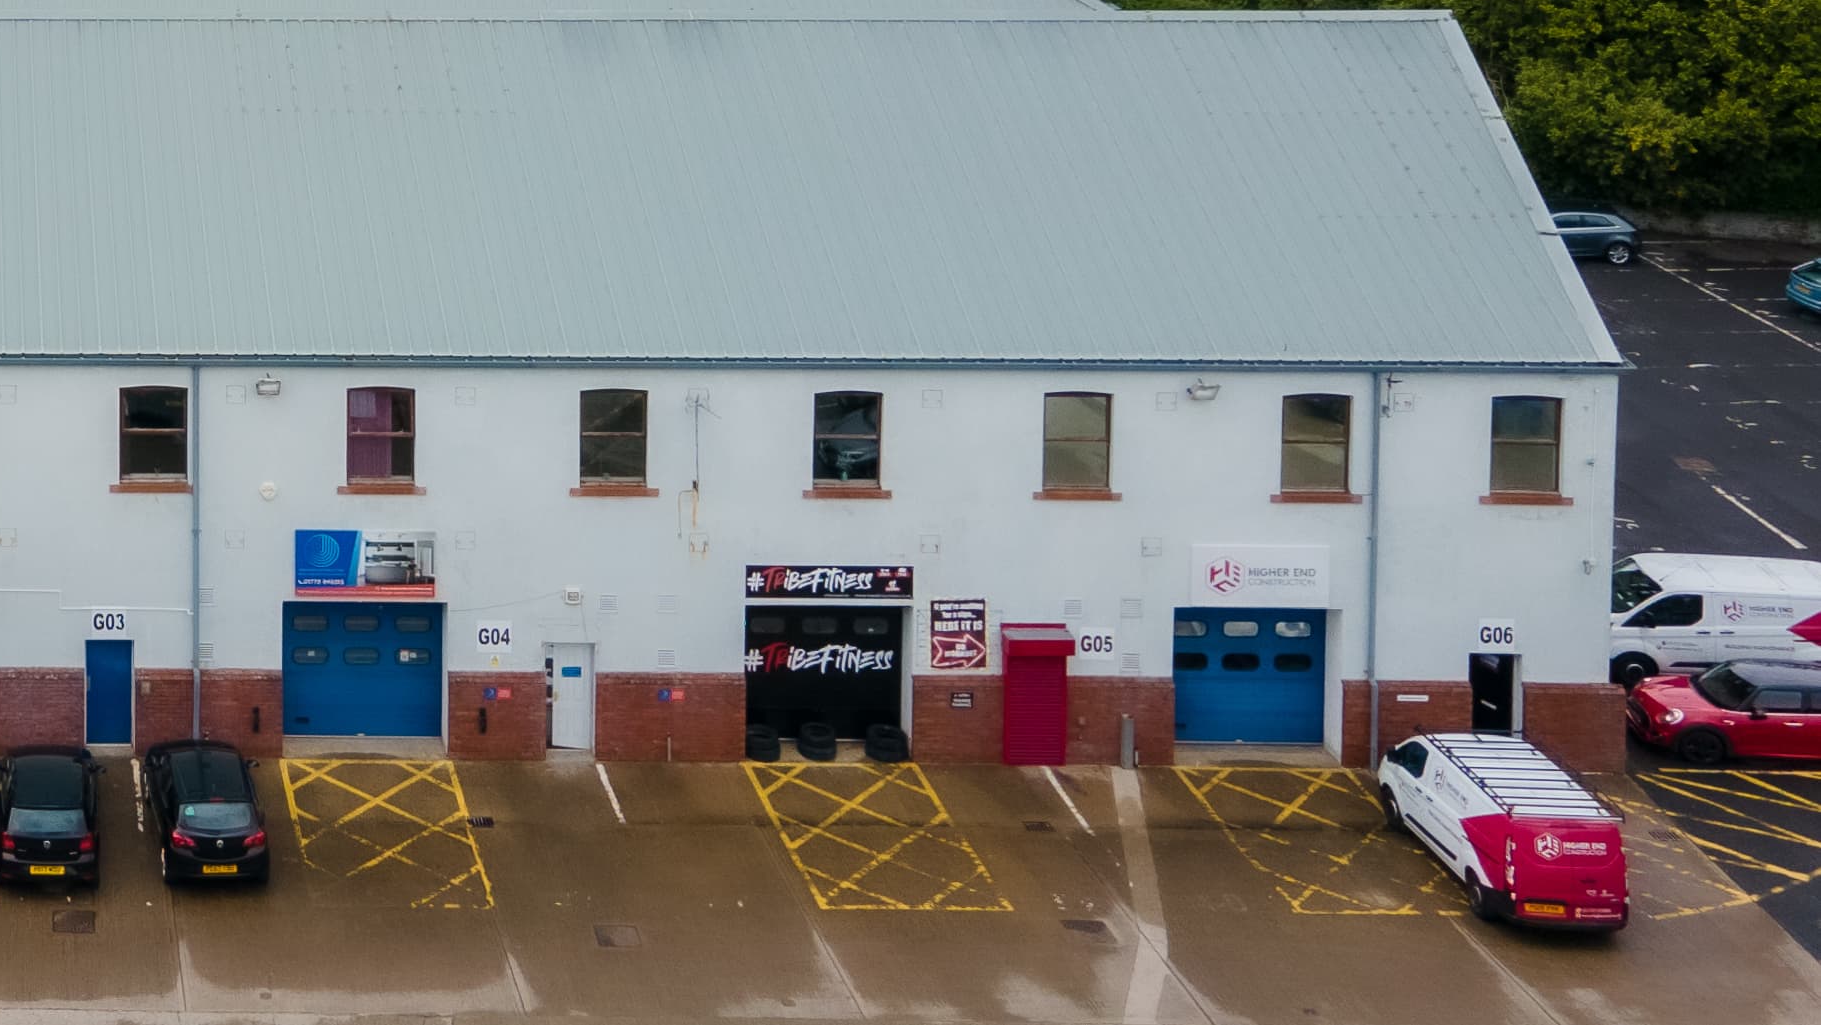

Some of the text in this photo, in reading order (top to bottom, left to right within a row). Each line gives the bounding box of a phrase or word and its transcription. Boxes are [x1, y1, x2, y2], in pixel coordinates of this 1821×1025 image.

[1248, 568, 1316, 577] HIGHER END
[1249, 578, 1315, 586] CONSTRUCTION
[93, 613, 124, 630] G03
[961, 621, 971, 631] IT
[973, 621, 983, 631] IS
[479, 628, 510, 645] G04
[1480, 626, 1514, 644] G06
[1081, 635, 1113, 653] G05
